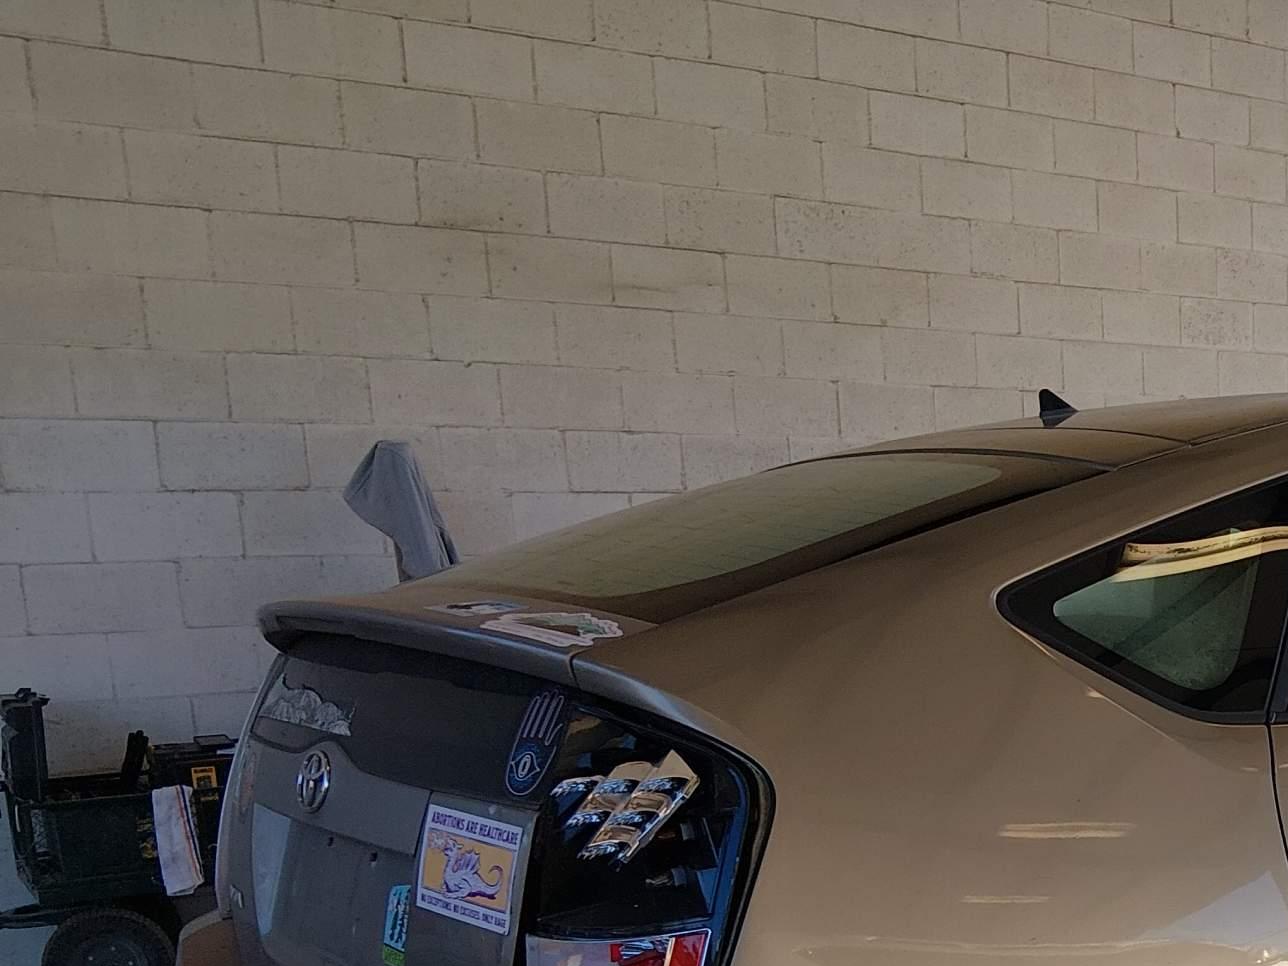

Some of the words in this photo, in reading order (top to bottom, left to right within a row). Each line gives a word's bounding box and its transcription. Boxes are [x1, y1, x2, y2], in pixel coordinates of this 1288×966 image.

[432, 810, 465, 830] ABORTIONS
[465, 820, 478, 834] ARE
[478, 823, 519, 845] HEALTHCARE
